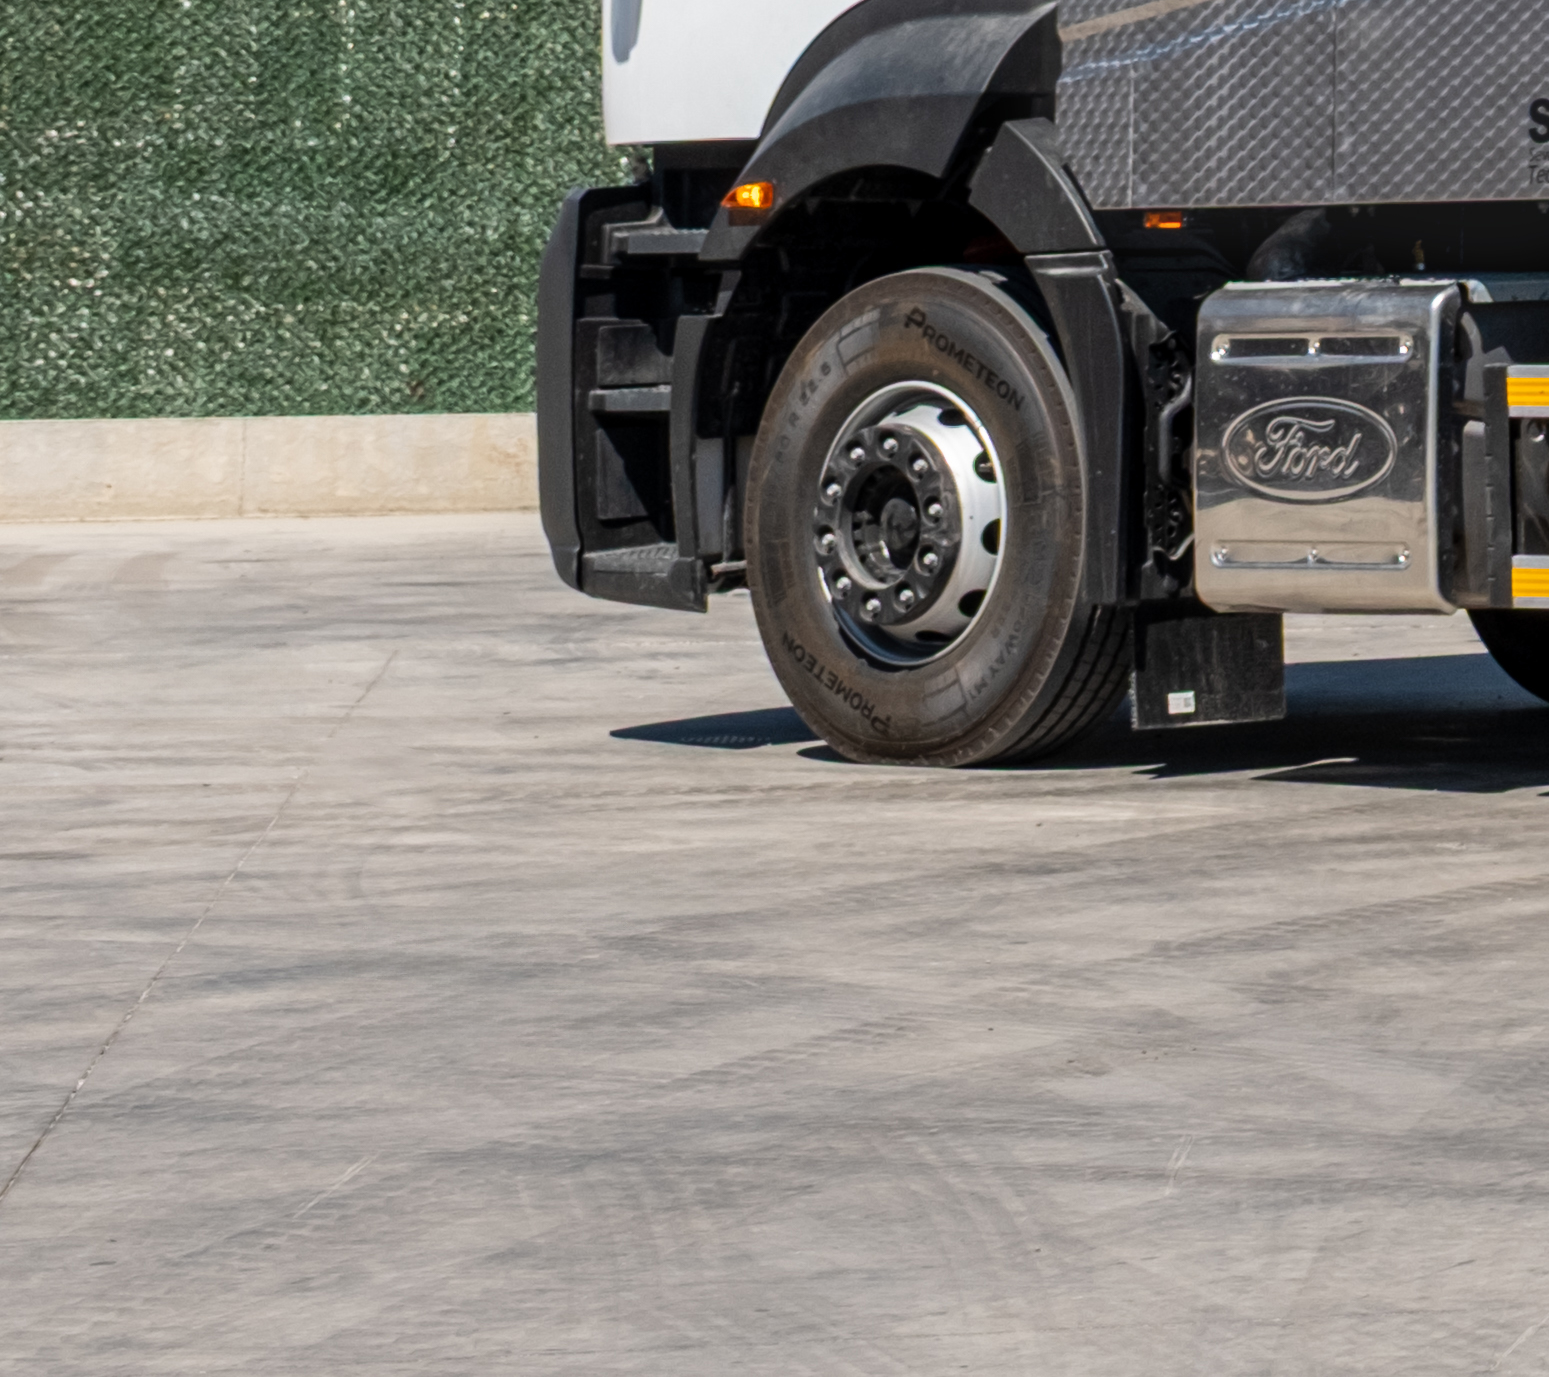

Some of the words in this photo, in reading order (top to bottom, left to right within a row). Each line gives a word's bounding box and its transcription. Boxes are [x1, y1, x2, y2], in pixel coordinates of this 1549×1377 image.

[903, 306, 1026, 412] PROMETEON
[1255, 415, 1363, 479] Ford
[782, 632, 893, 736] PROMETEON
